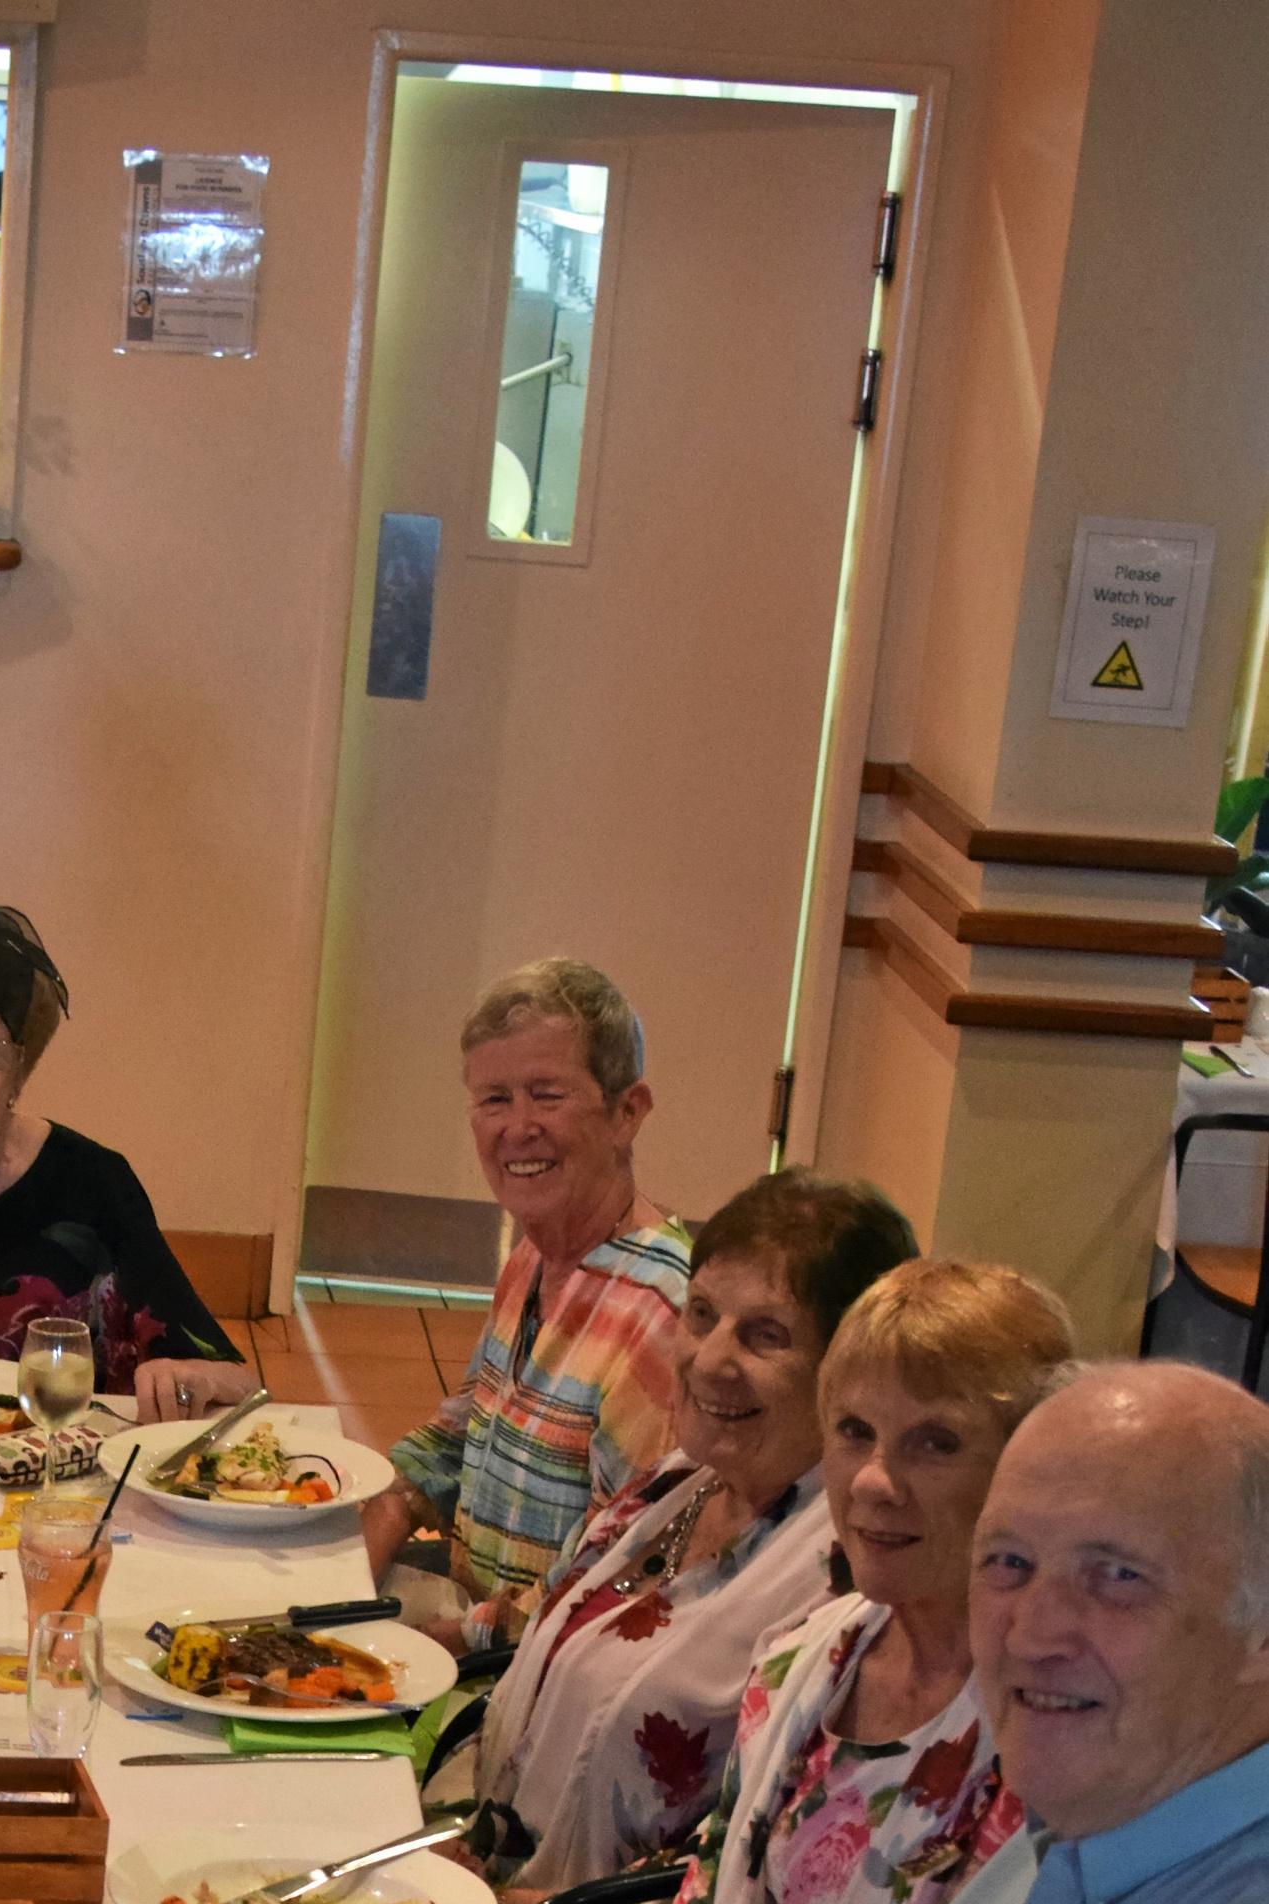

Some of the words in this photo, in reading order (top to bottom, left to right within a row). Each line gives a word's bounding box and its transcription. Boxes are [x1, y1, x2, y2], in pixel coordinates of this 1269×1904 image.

[1115, 565, 1162, 582] Please
[1093, 588, 1139, 605] Watch
[1144, 591, 1178, 608] Your
[1111, 613, 1150, 630] Step!
